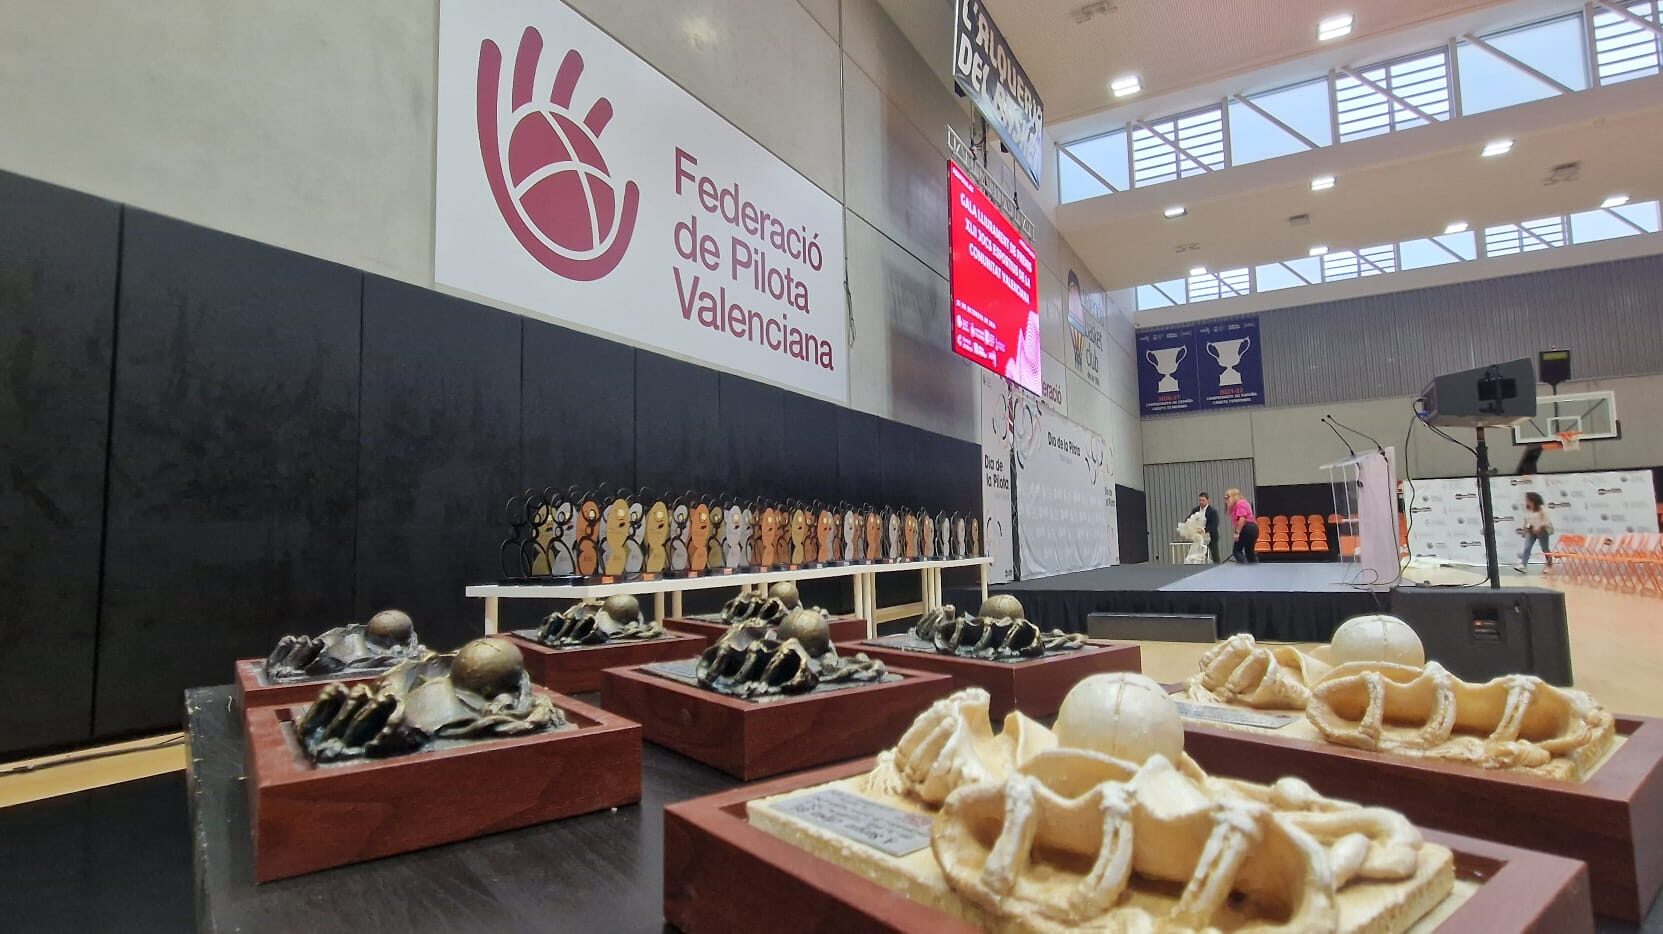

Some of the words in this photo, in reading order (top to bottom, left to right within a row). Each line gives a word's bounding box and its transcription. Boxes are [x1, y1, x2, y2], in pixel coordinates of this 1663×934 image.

[958, 33, 990, 104] DEL
[675, 146, 823, 271] Federació
[960, 192, 977, 219] GALA
[1009, 240, 1017, 257] DE
[674, 215, 720, 271] de
[732, 236, 810, 314] Pilota
[673, 266, 834, 371] Valenciana
[1042, 381, 1062, 405] eració
[984, 454, 995, 470] Dia
[995, 457, 1004, 472] de
[986, 473, 992, 488] la
[993, 473, 1009, 489] Pilota
